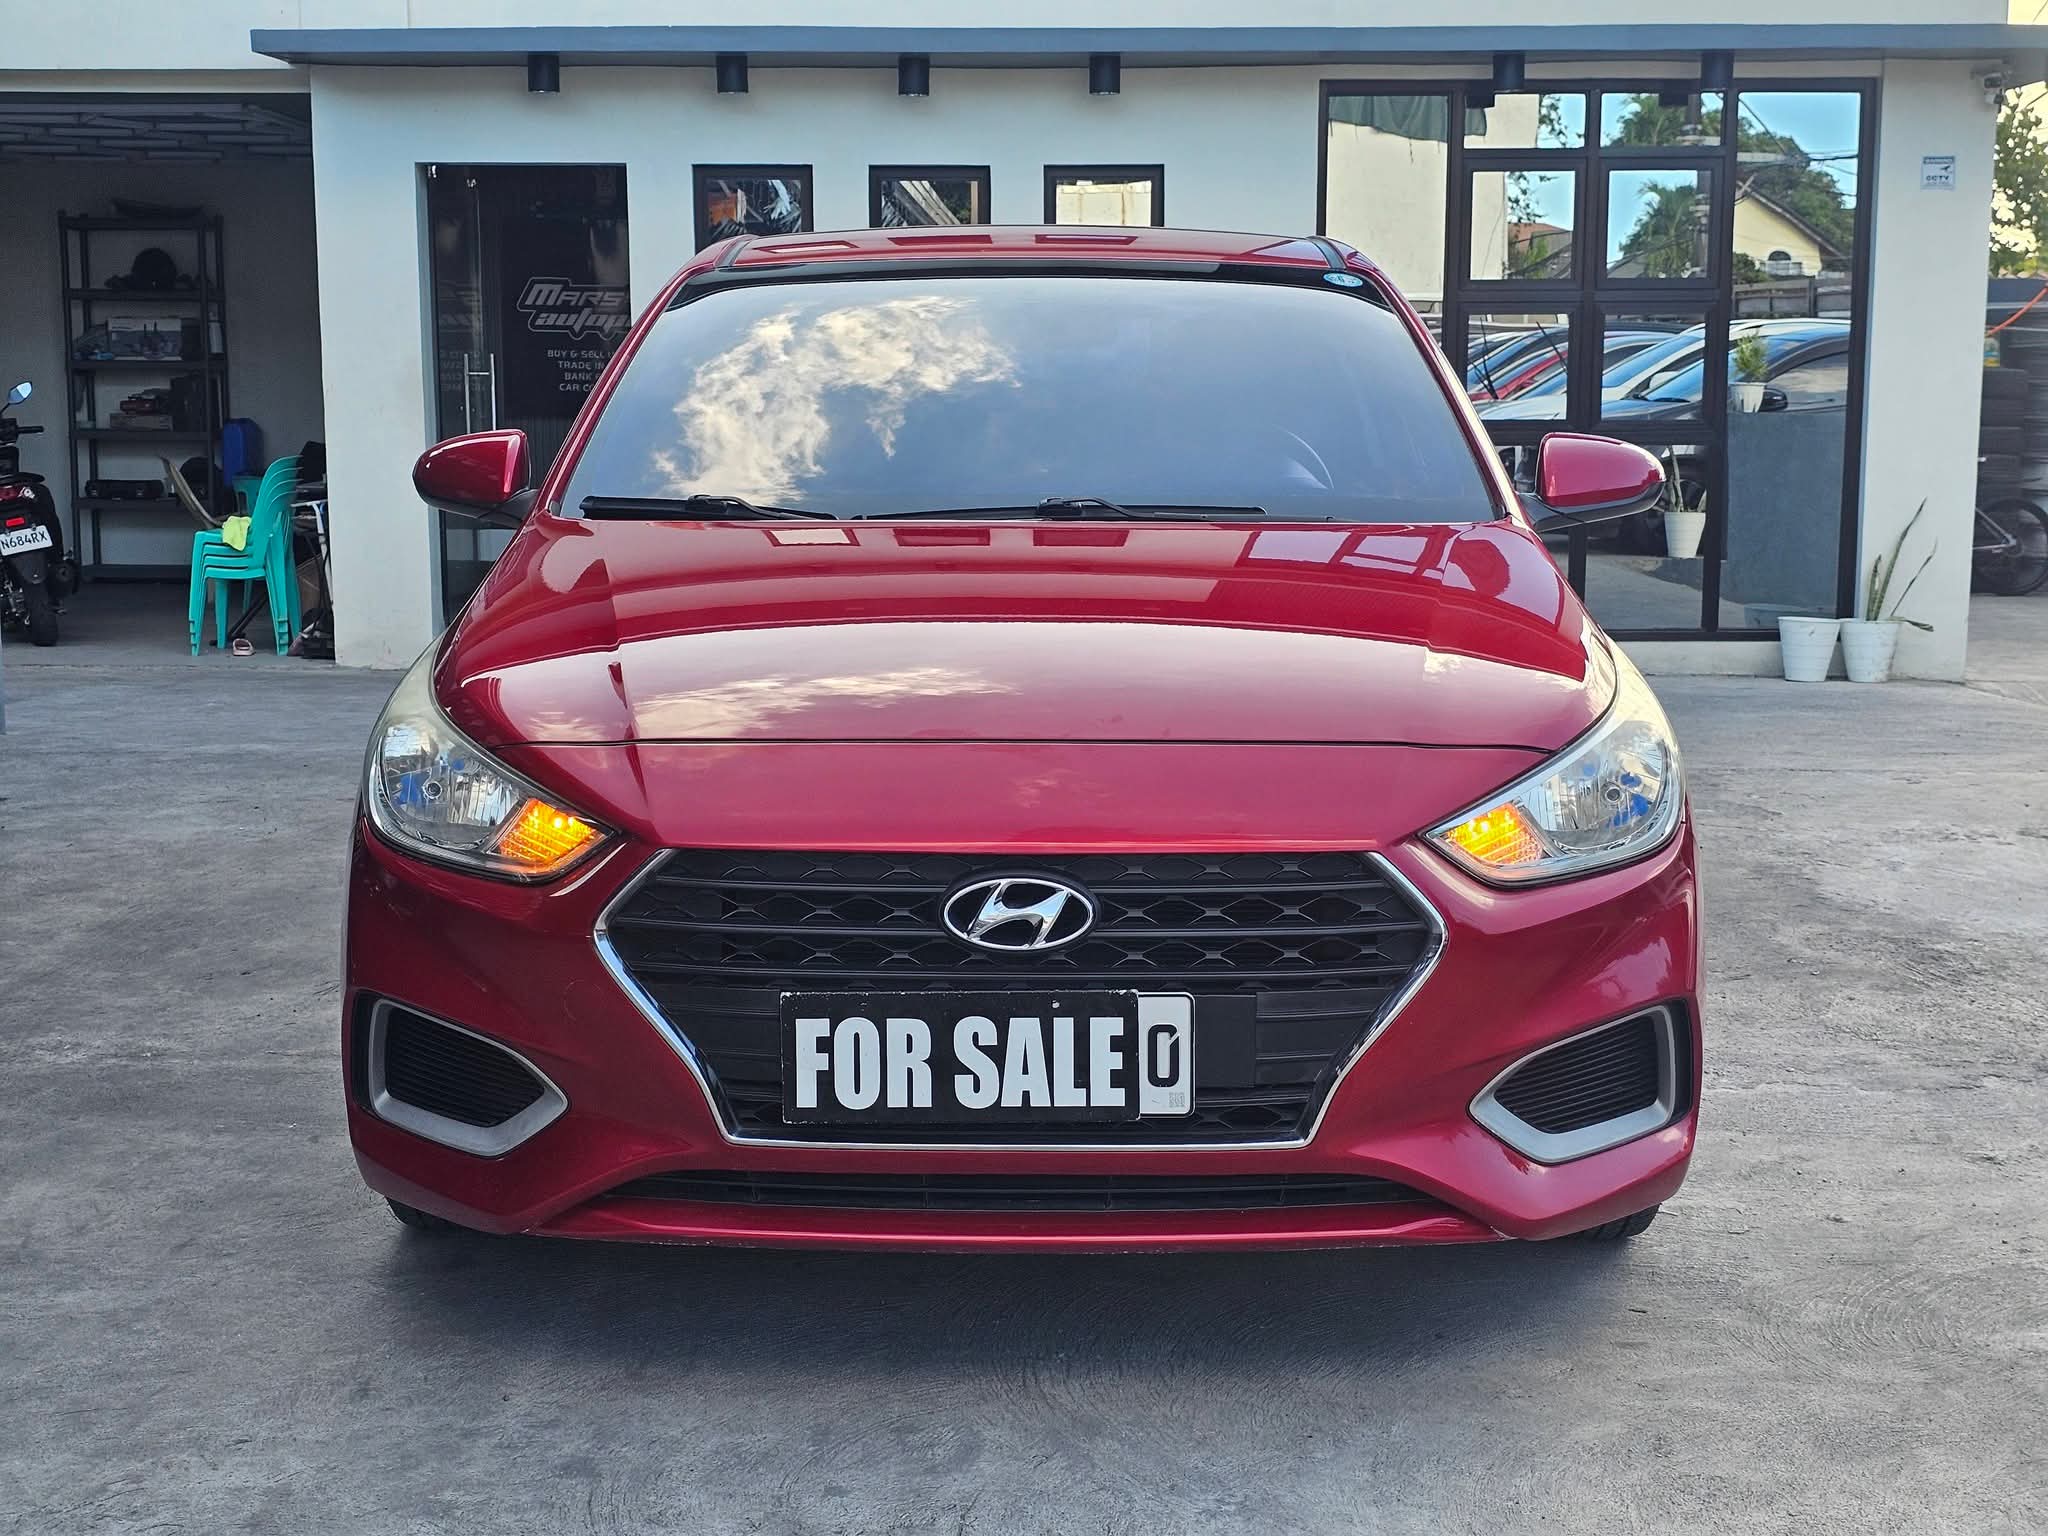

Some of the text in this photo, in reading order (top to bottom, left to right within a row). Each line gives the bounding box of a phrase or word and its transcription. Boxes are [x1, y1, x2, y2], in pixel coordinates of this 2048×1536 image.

[547, 349, 567, 358] BUY
[581, 350, 605, 359] SELL
[558, 360, 592, 370] TRADE
[564, 372, 592, 381] BANK
[559, 383, 580, 392] CAR
[1, 531, 48, 550] N684RX
[795, 1016, 1126, 1110] FOR SALE
